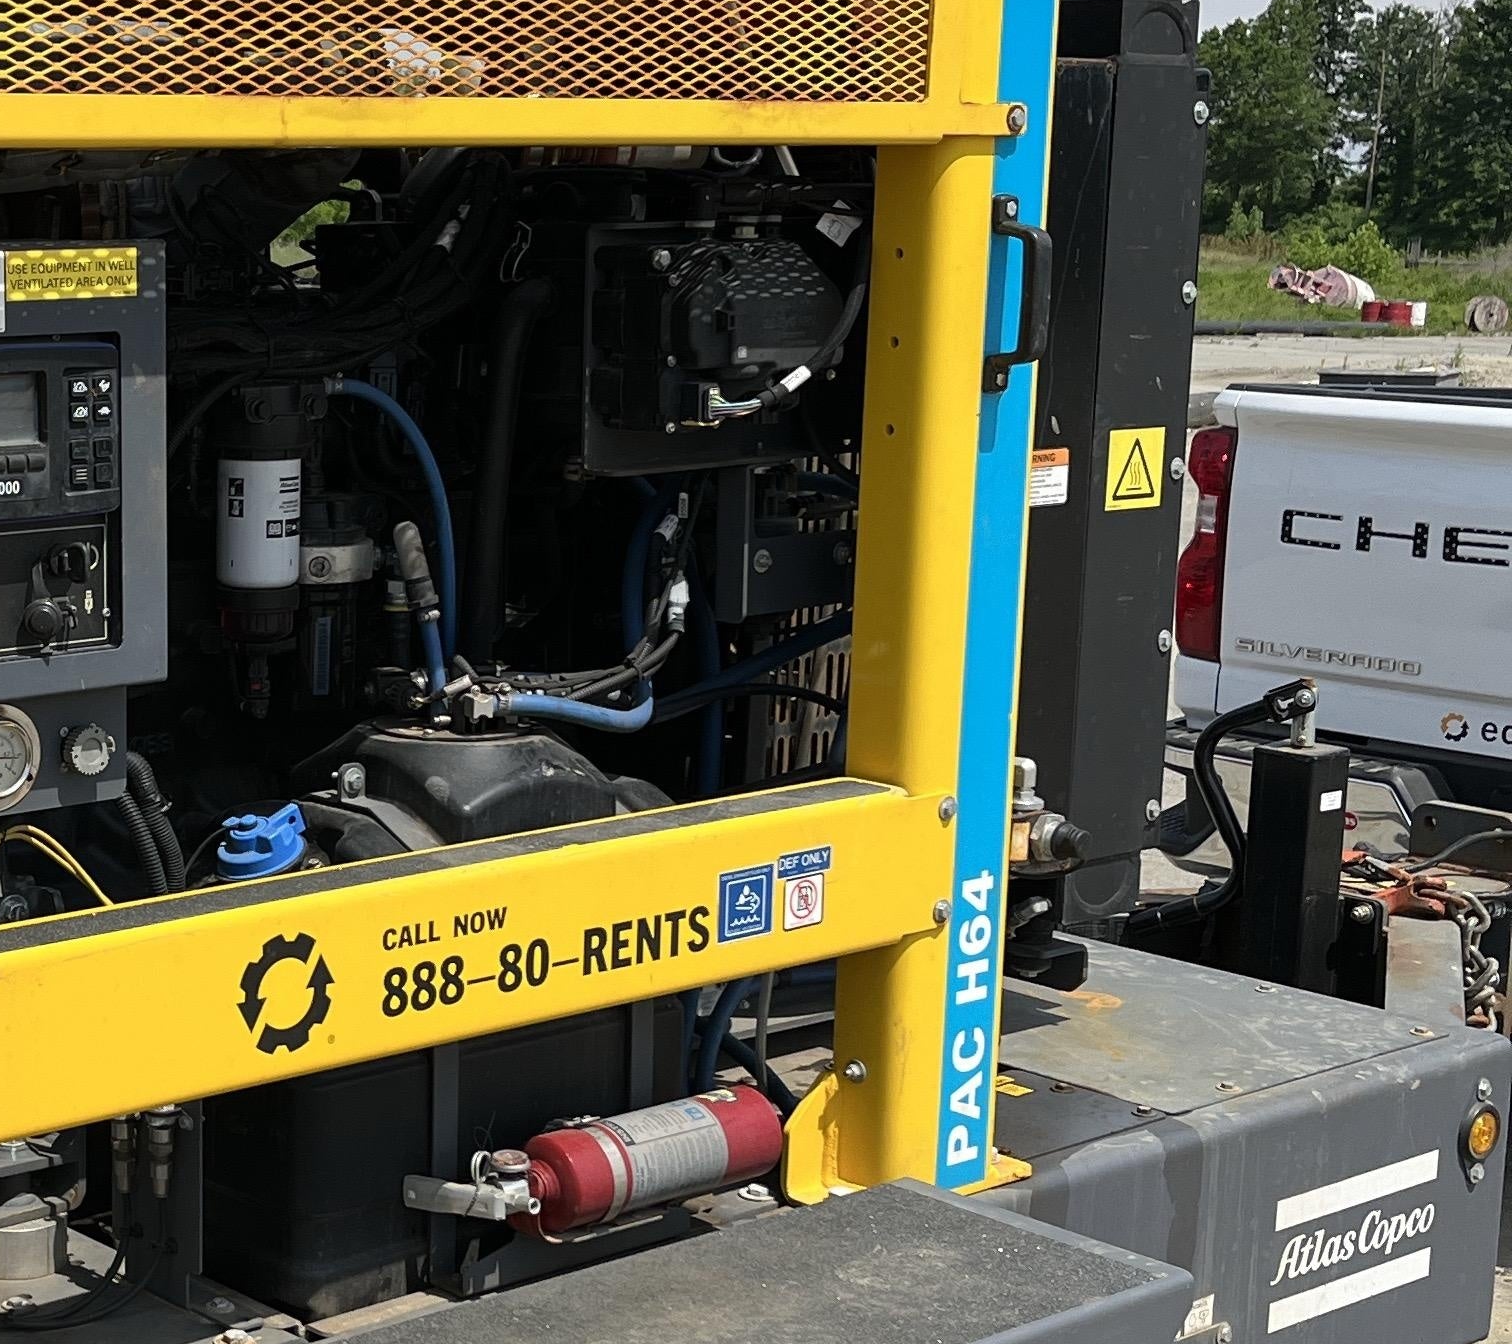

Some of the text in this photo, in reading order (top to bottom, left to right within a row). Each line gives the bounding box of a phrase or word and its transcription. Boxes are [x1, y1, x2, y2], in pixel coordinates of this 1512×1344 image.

[7, 259, 136, 275] USE EQUIPMENT IN WELL
[9, 274, 133, 290] VENTILATED AREA ONLY
[1235, 636, 1422, 677] SILVERADO
[778, 849, 830, 871] DEF ONLY
[382, 906, 508, 952] CALL NOW
[947, 869, 996, 1167] PAC H64
[1270, 1203, 1435, 1287] Atlas Copco
